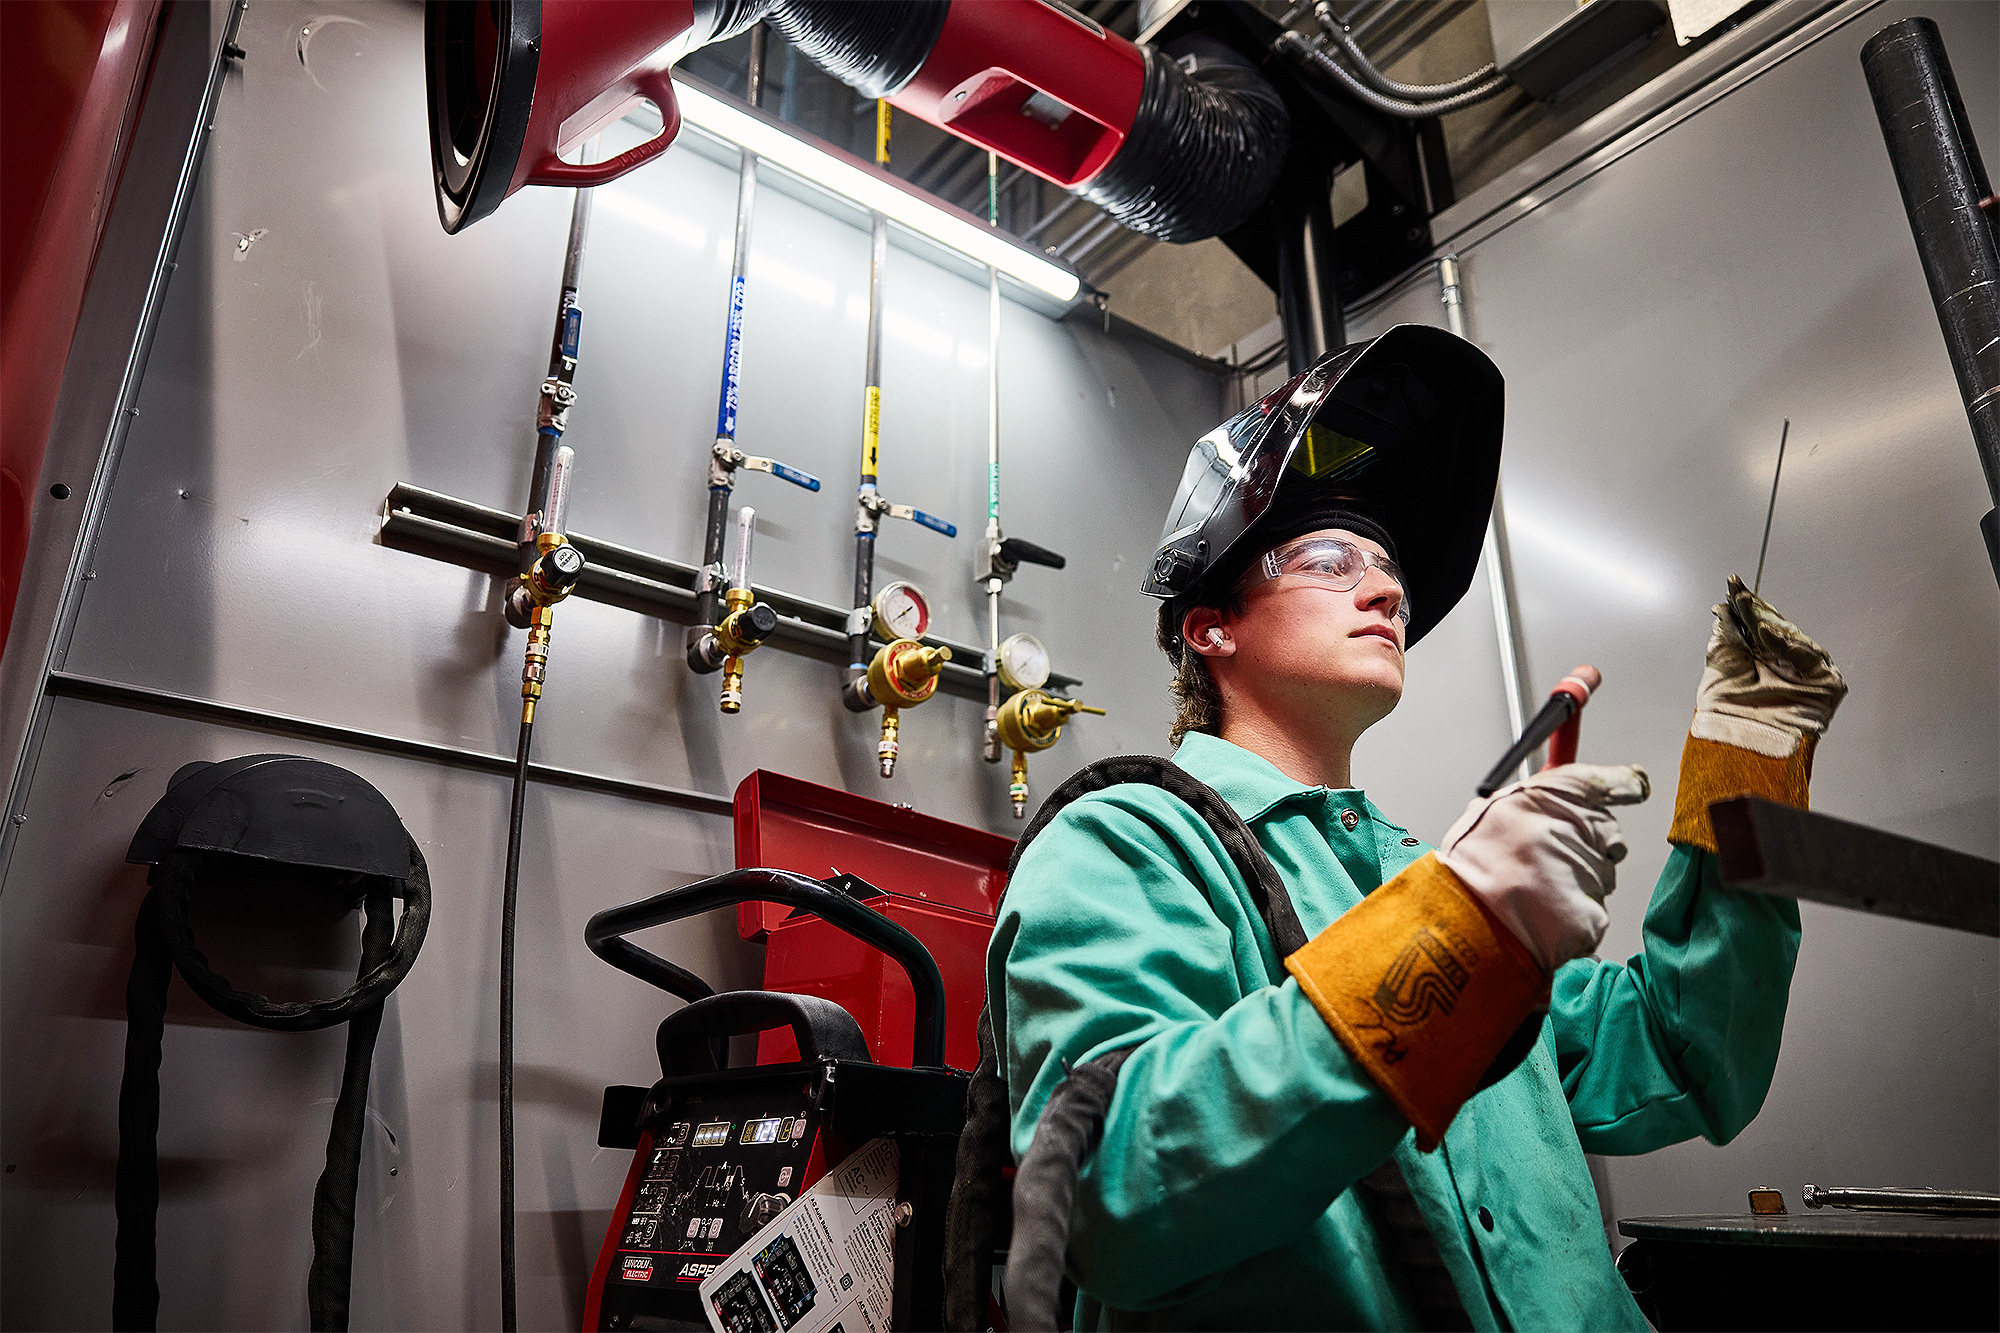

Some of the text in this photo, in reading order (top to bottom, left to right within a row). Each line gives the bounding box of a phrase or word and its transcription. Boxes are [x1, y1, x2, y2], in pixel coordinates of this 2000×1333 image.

[881, 1142, 893, 1160] DC
[851, 1167, 864, 1185] AC
[810, 1197, 817, 1207] AC
[814, 1206, 823, 1220] Auto
[624, 1259, 650, 1269] LINCOLN
[679, 1263, 719, 1277] ASPE
[626, 1270, 649, 1279] ELECTRIC
[857, 1300, 866, 1309] AC
[862, 1308, 872, 1324] Wave
